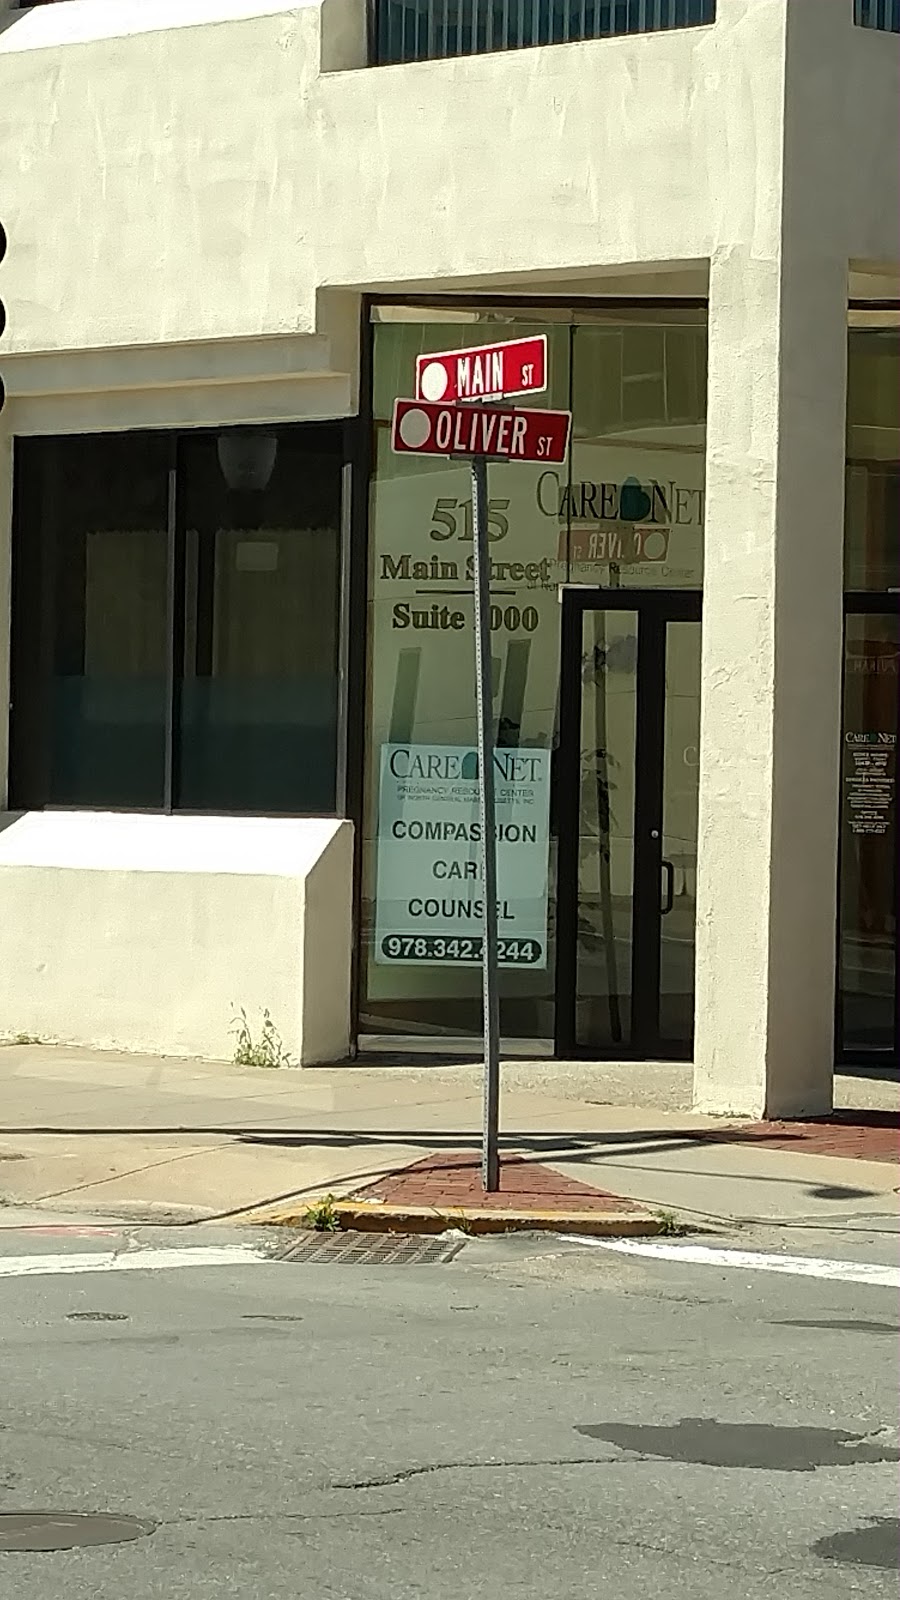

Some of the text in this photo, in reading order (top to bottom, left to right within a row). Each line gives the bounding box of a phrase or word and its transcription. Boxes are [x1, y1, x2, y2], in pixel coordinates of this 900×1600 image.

[457, 350, 534, 397] MAIN ST
[436, 410, 553, 456] OLIVER ST
[536, 470, 619, 520] CARE
[430, 498, 511, 542] 515
[379, 554, 459, 580] Main
[392, 603, 539, 632] Suite 000
[389, 749, 461, 780] CARE
[392, 820, 537, 843] COMPASION
[432, 860, 483, 880] CAR
[388, 937, 535, 961] 978.342.244
